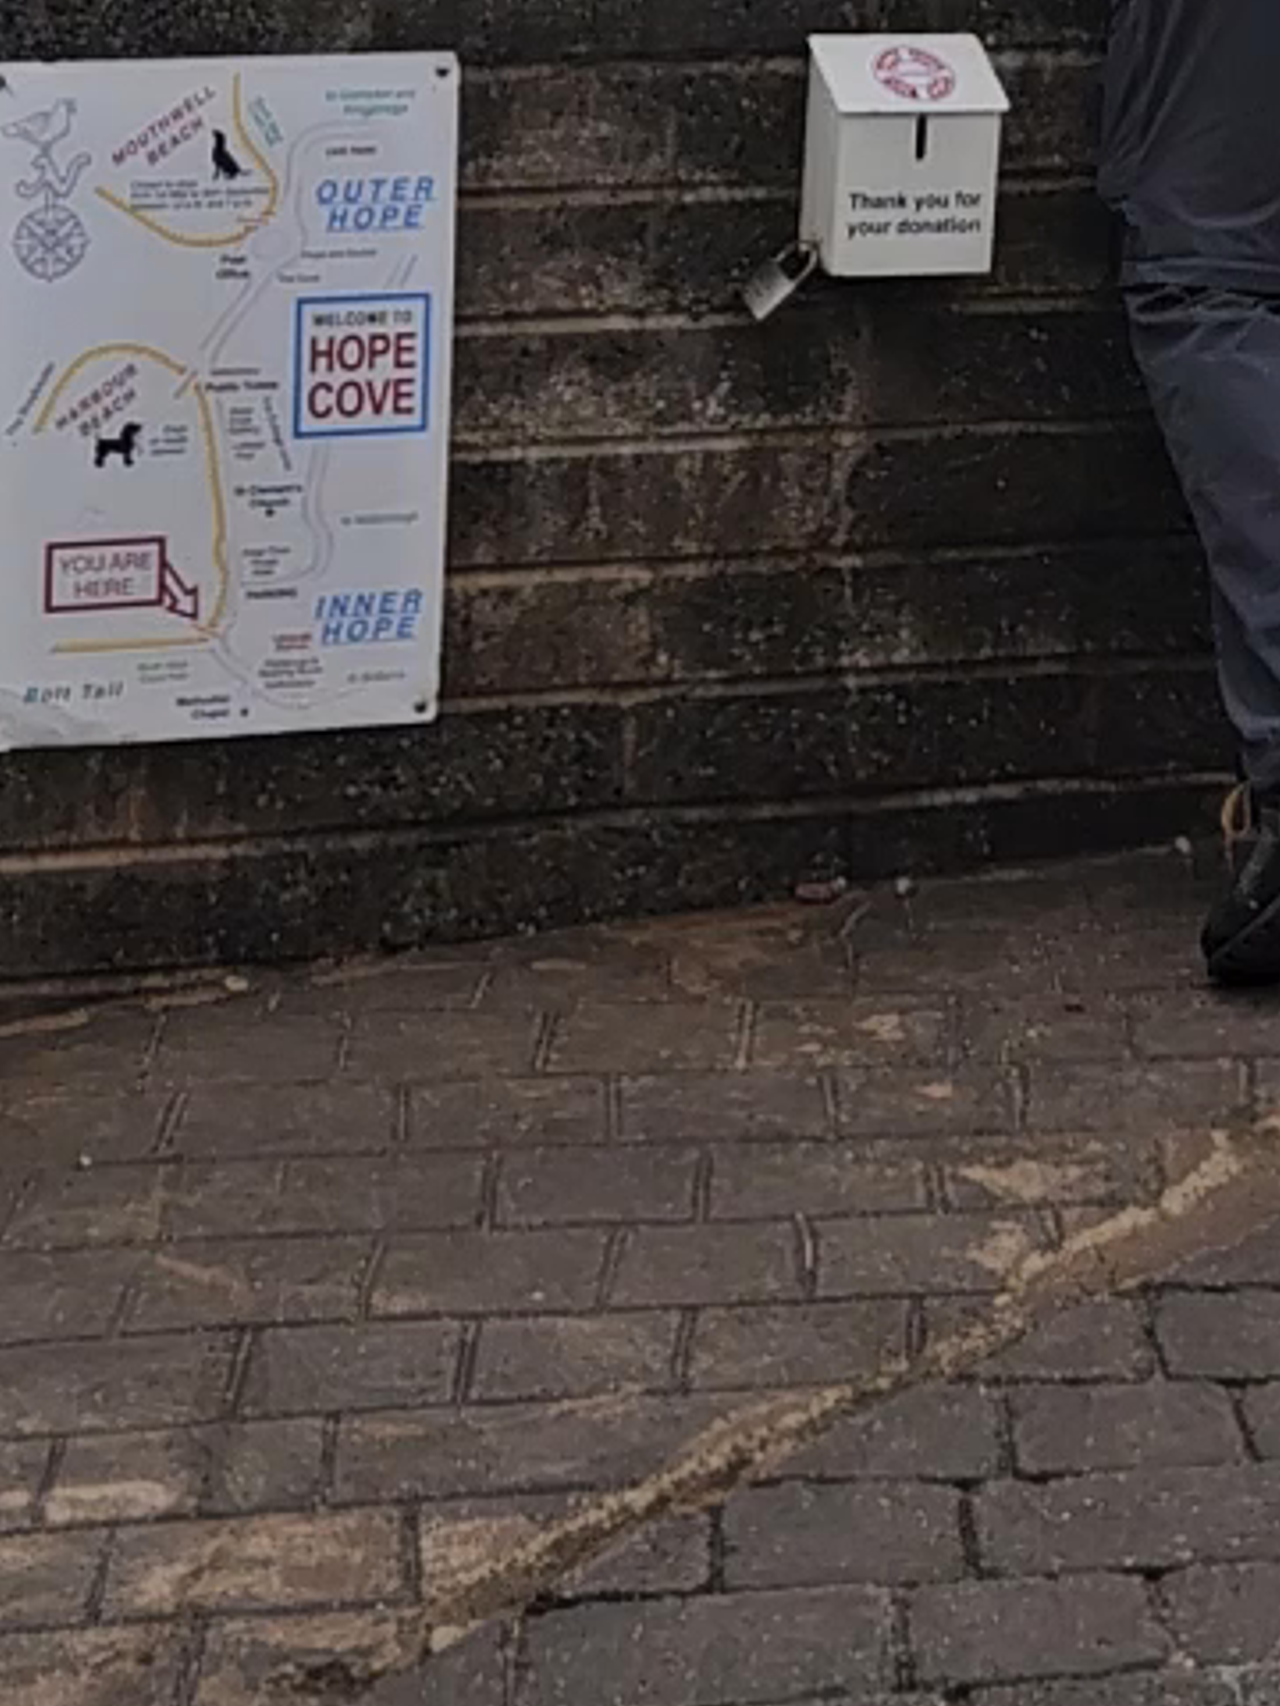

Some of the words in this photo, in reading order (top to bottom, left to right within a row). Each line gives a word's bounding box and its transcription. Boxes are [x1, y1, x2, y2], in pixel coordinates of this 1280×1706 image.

[316, 177, 434, 205] OUTER
[849, 191, 907, 211] Thank
[913, 193, 950, 213] you
[955, 190, 982, 208] for
[327, 205, 422, 231] HOPE
[847, 221, 892, 240] your
[896, 216, 981, 235] donation
[312, 311, 387, 328] WELCOME
[393, 310, 412, 324] TO
[309, 332, 417, 375] HOPE
[308, 378, 415, 419] COVE
[58, 555, 106, 574] YOU
[109, 551, 154, 571] ARE
[73, 577, 132, 598] HERE
[316, 589, 422, 620] INNER
[321, 616, 416, 646] HOPE
